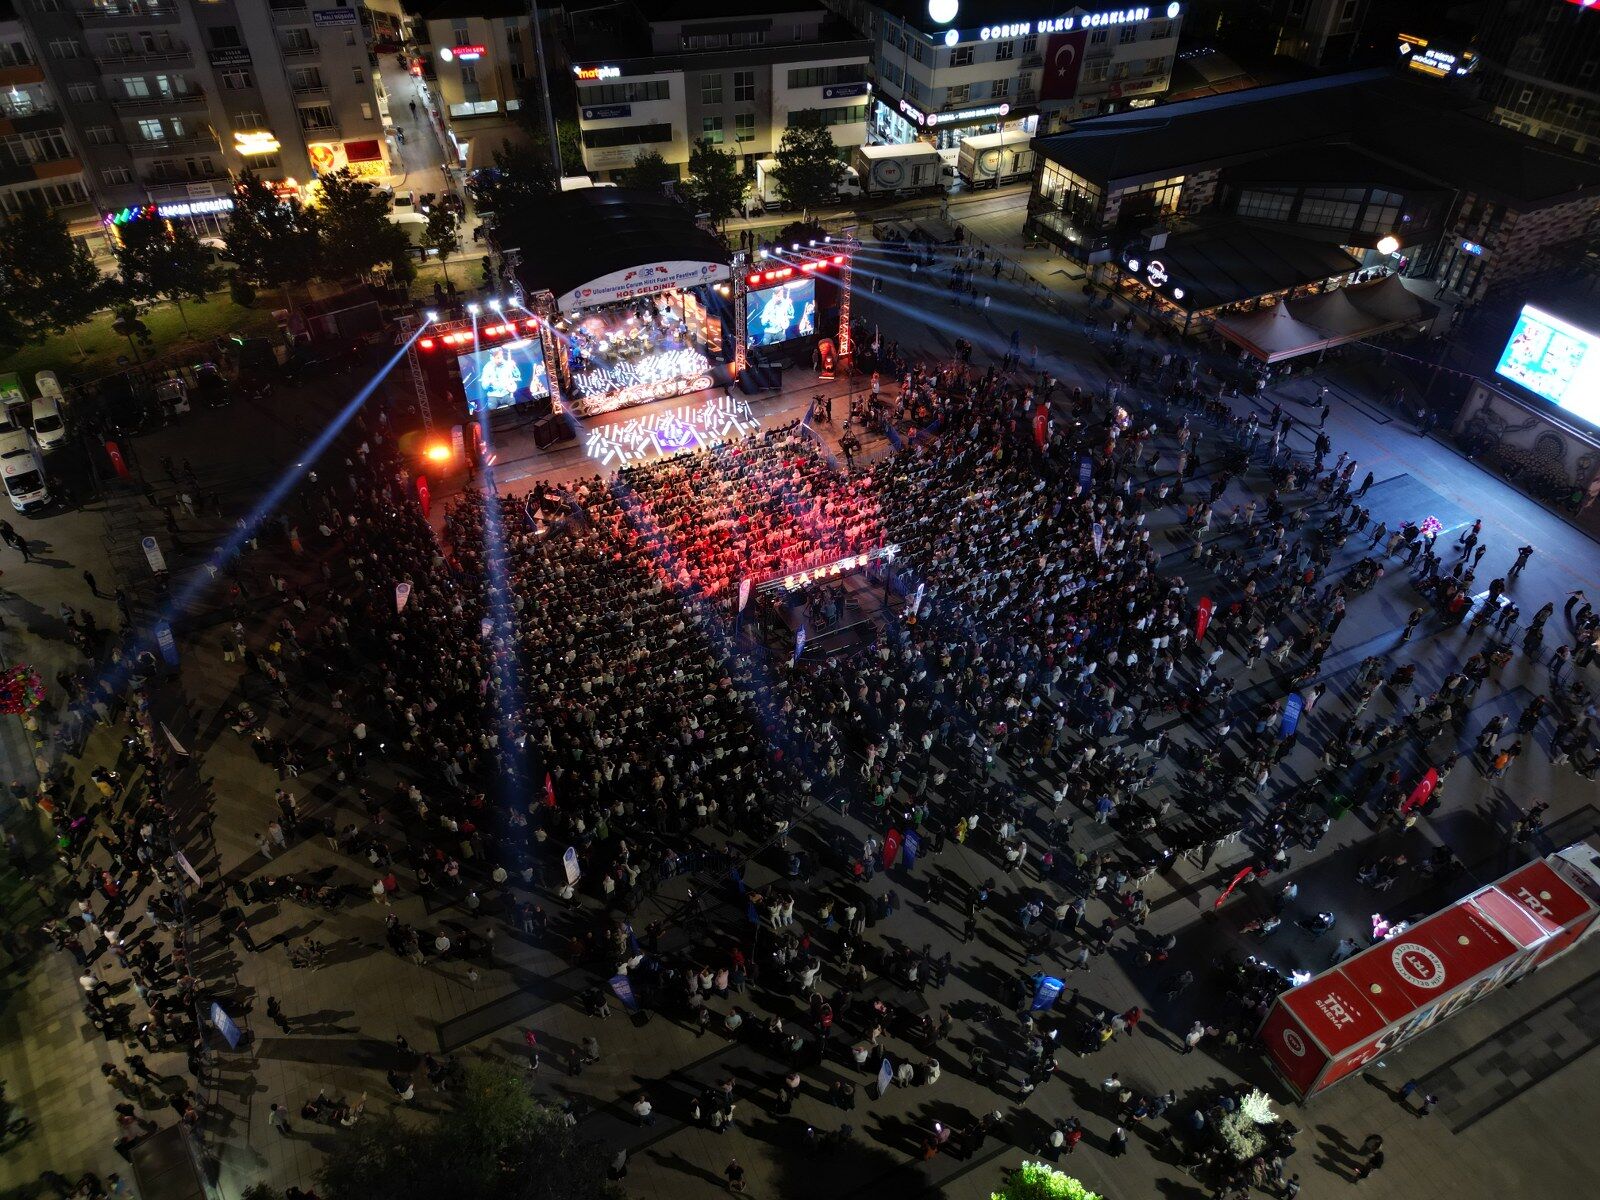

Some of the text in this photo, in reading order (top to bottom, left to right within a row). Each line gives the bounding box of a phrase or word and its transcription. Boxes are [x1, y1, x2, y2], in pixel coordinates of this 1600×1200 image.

[1081, 7, 1150, 28] OCAKLARI
[637, 281, 676, 294] GELDİNİZ
[1517, 886, 1554, 917] TRT
[1405, 955, 1430, 978] TRT
[1315, 999, 1343, 1031] SİNEMA
[1324, 994, 1355, 1023] TRT
